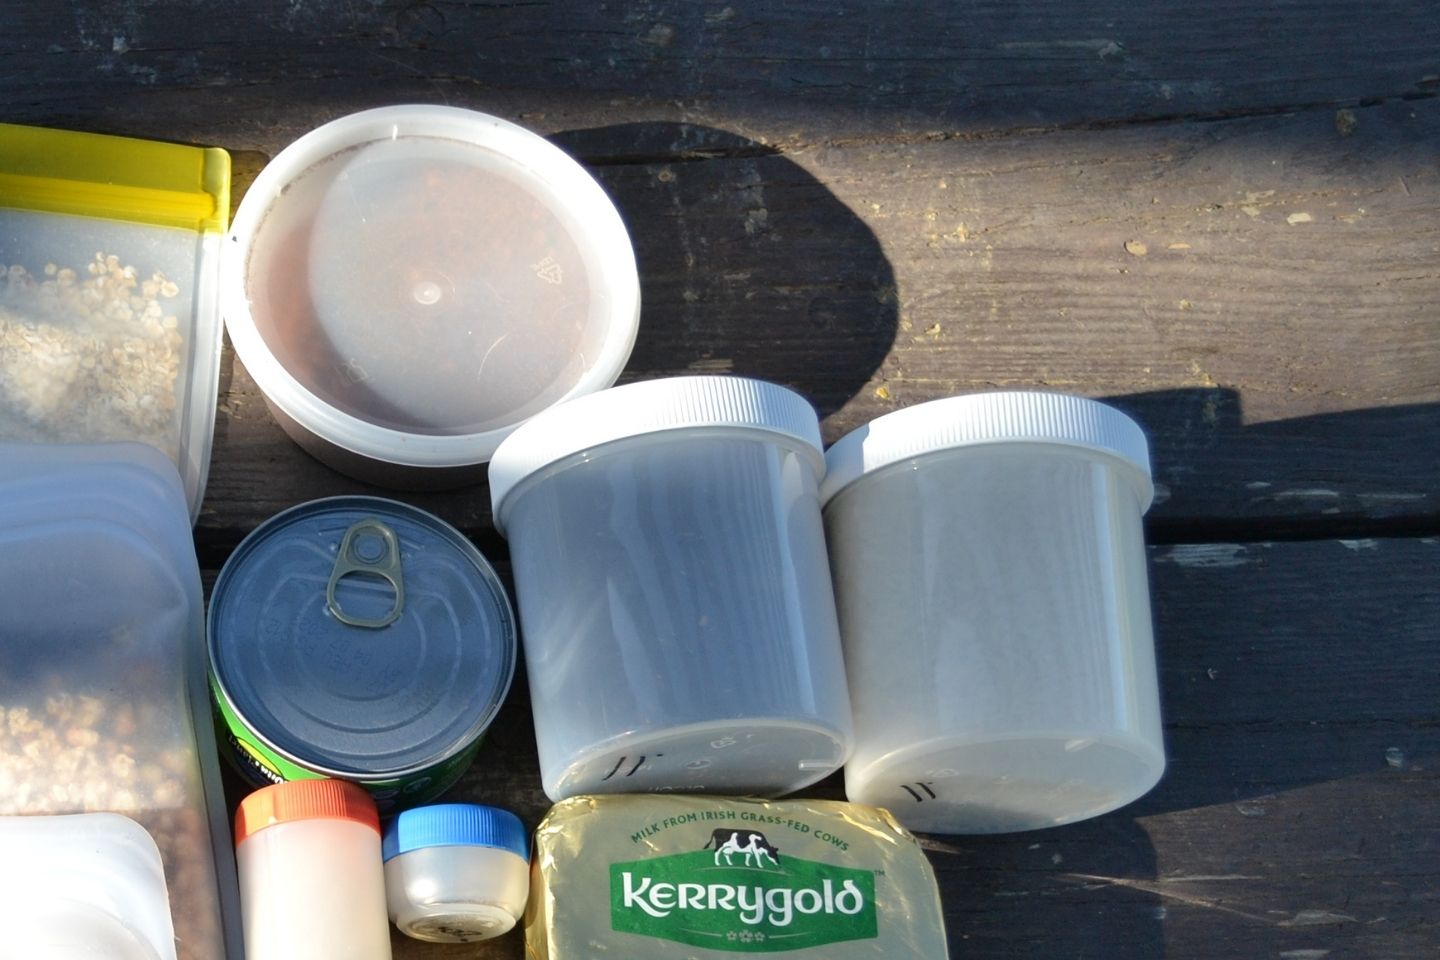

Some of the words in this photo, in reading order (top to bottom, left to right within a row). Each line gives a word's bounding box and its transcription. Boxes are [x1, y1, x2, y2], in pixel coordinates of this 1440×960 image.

[631, 823, 661, 844] MILK
[663, 811, 697, 829] FROM
[700, 810, 736, 820] IRISH
[741, 811, 810, 834] GRASS-FED
[814, 829, 850, 852] COWS
